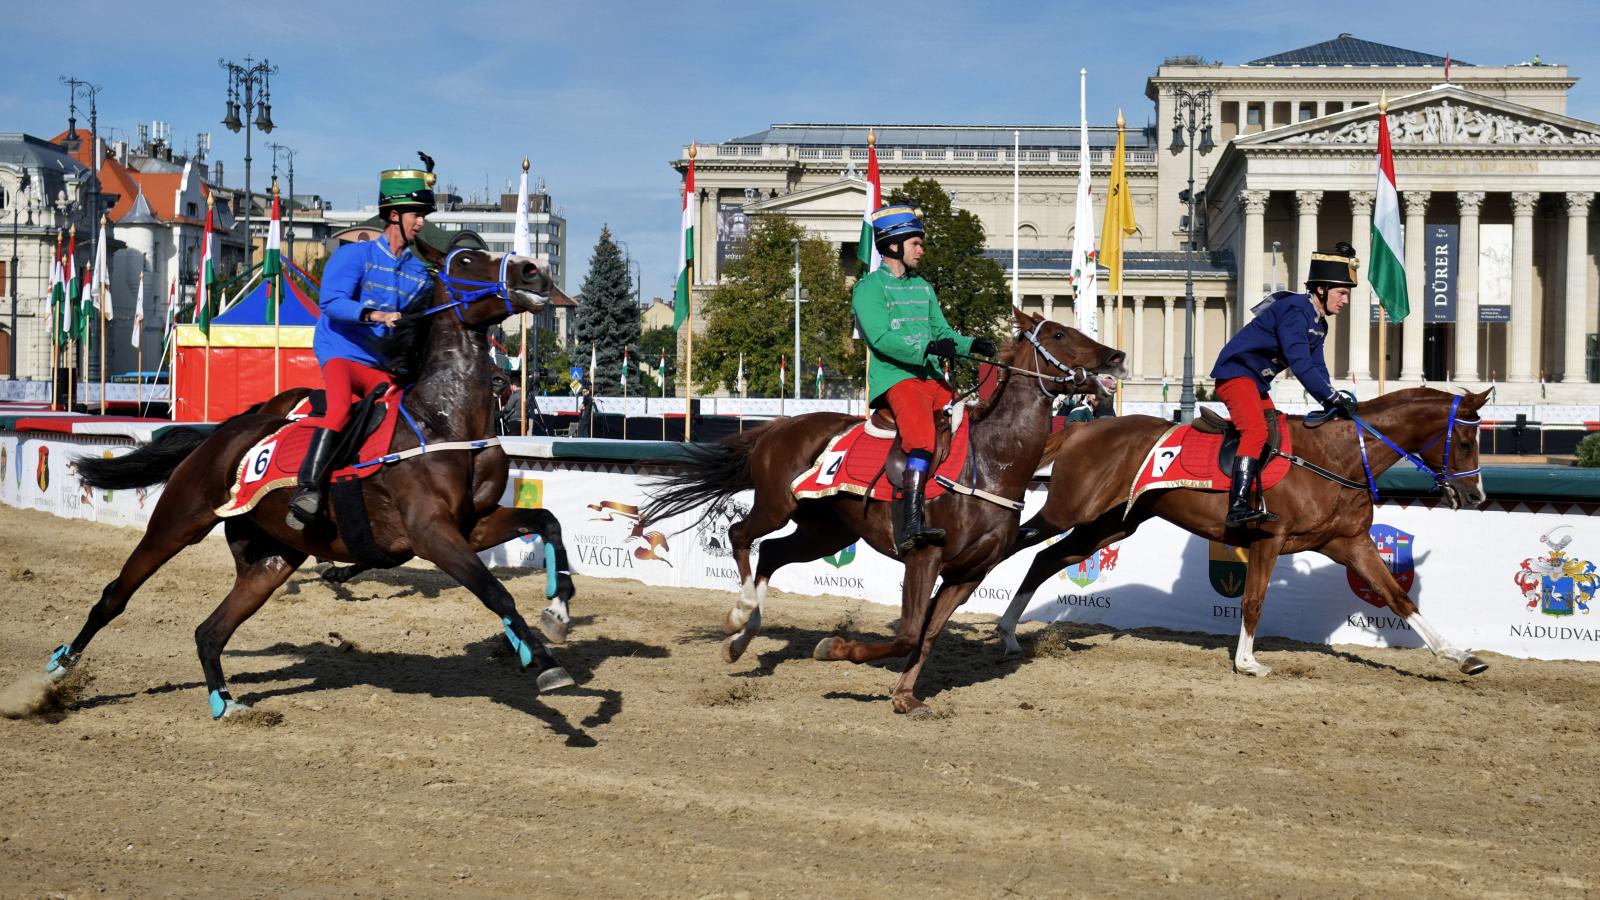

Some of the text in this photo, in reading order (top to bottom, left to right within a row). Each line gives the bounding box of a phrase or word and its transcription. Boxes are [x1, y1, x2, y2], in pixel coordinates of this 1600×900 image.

[1432, 244, 1448, 306] DÜRER
[255, 449, 270, 475] 6
[826, 456, 842, 475] 4
[574, 535, 606, 544] NEMZETI
[577, 544, 633, 568] VÁGTA
[814, 574, 864, 588] MÁNDOK
[1056, 593, 1111, 608] MOHÁCS
[1347, 615, 1411, 630] KAPUVA
